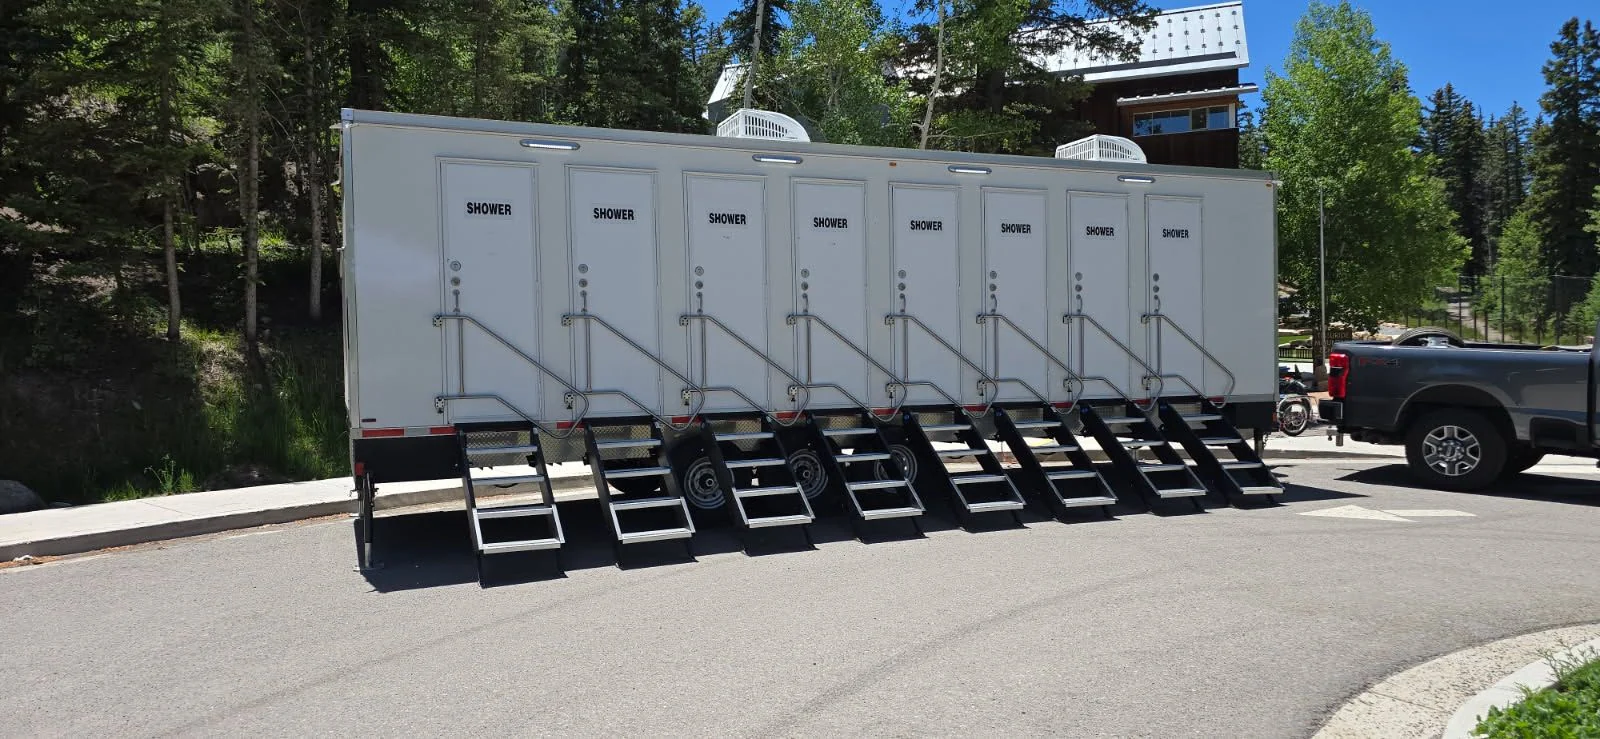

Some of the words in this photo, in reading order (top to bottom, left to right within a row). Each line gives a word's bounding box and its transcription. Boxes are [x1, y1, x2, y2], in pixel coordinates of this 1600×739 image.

[466, 202, 512, 216] SHOWER
[593, 207, 635, 221] SHOWER
[709, 212, 747, 225] SHOWER
[813, 216, 848, 229] SHOWER
[910, 219, 943, 231] SHOWER
[1001, 222, 1032, 234] SHOWER
[1086, 225, 1115, 237] SHOWER
[1162, 228, 1190, 239] SHOWER
